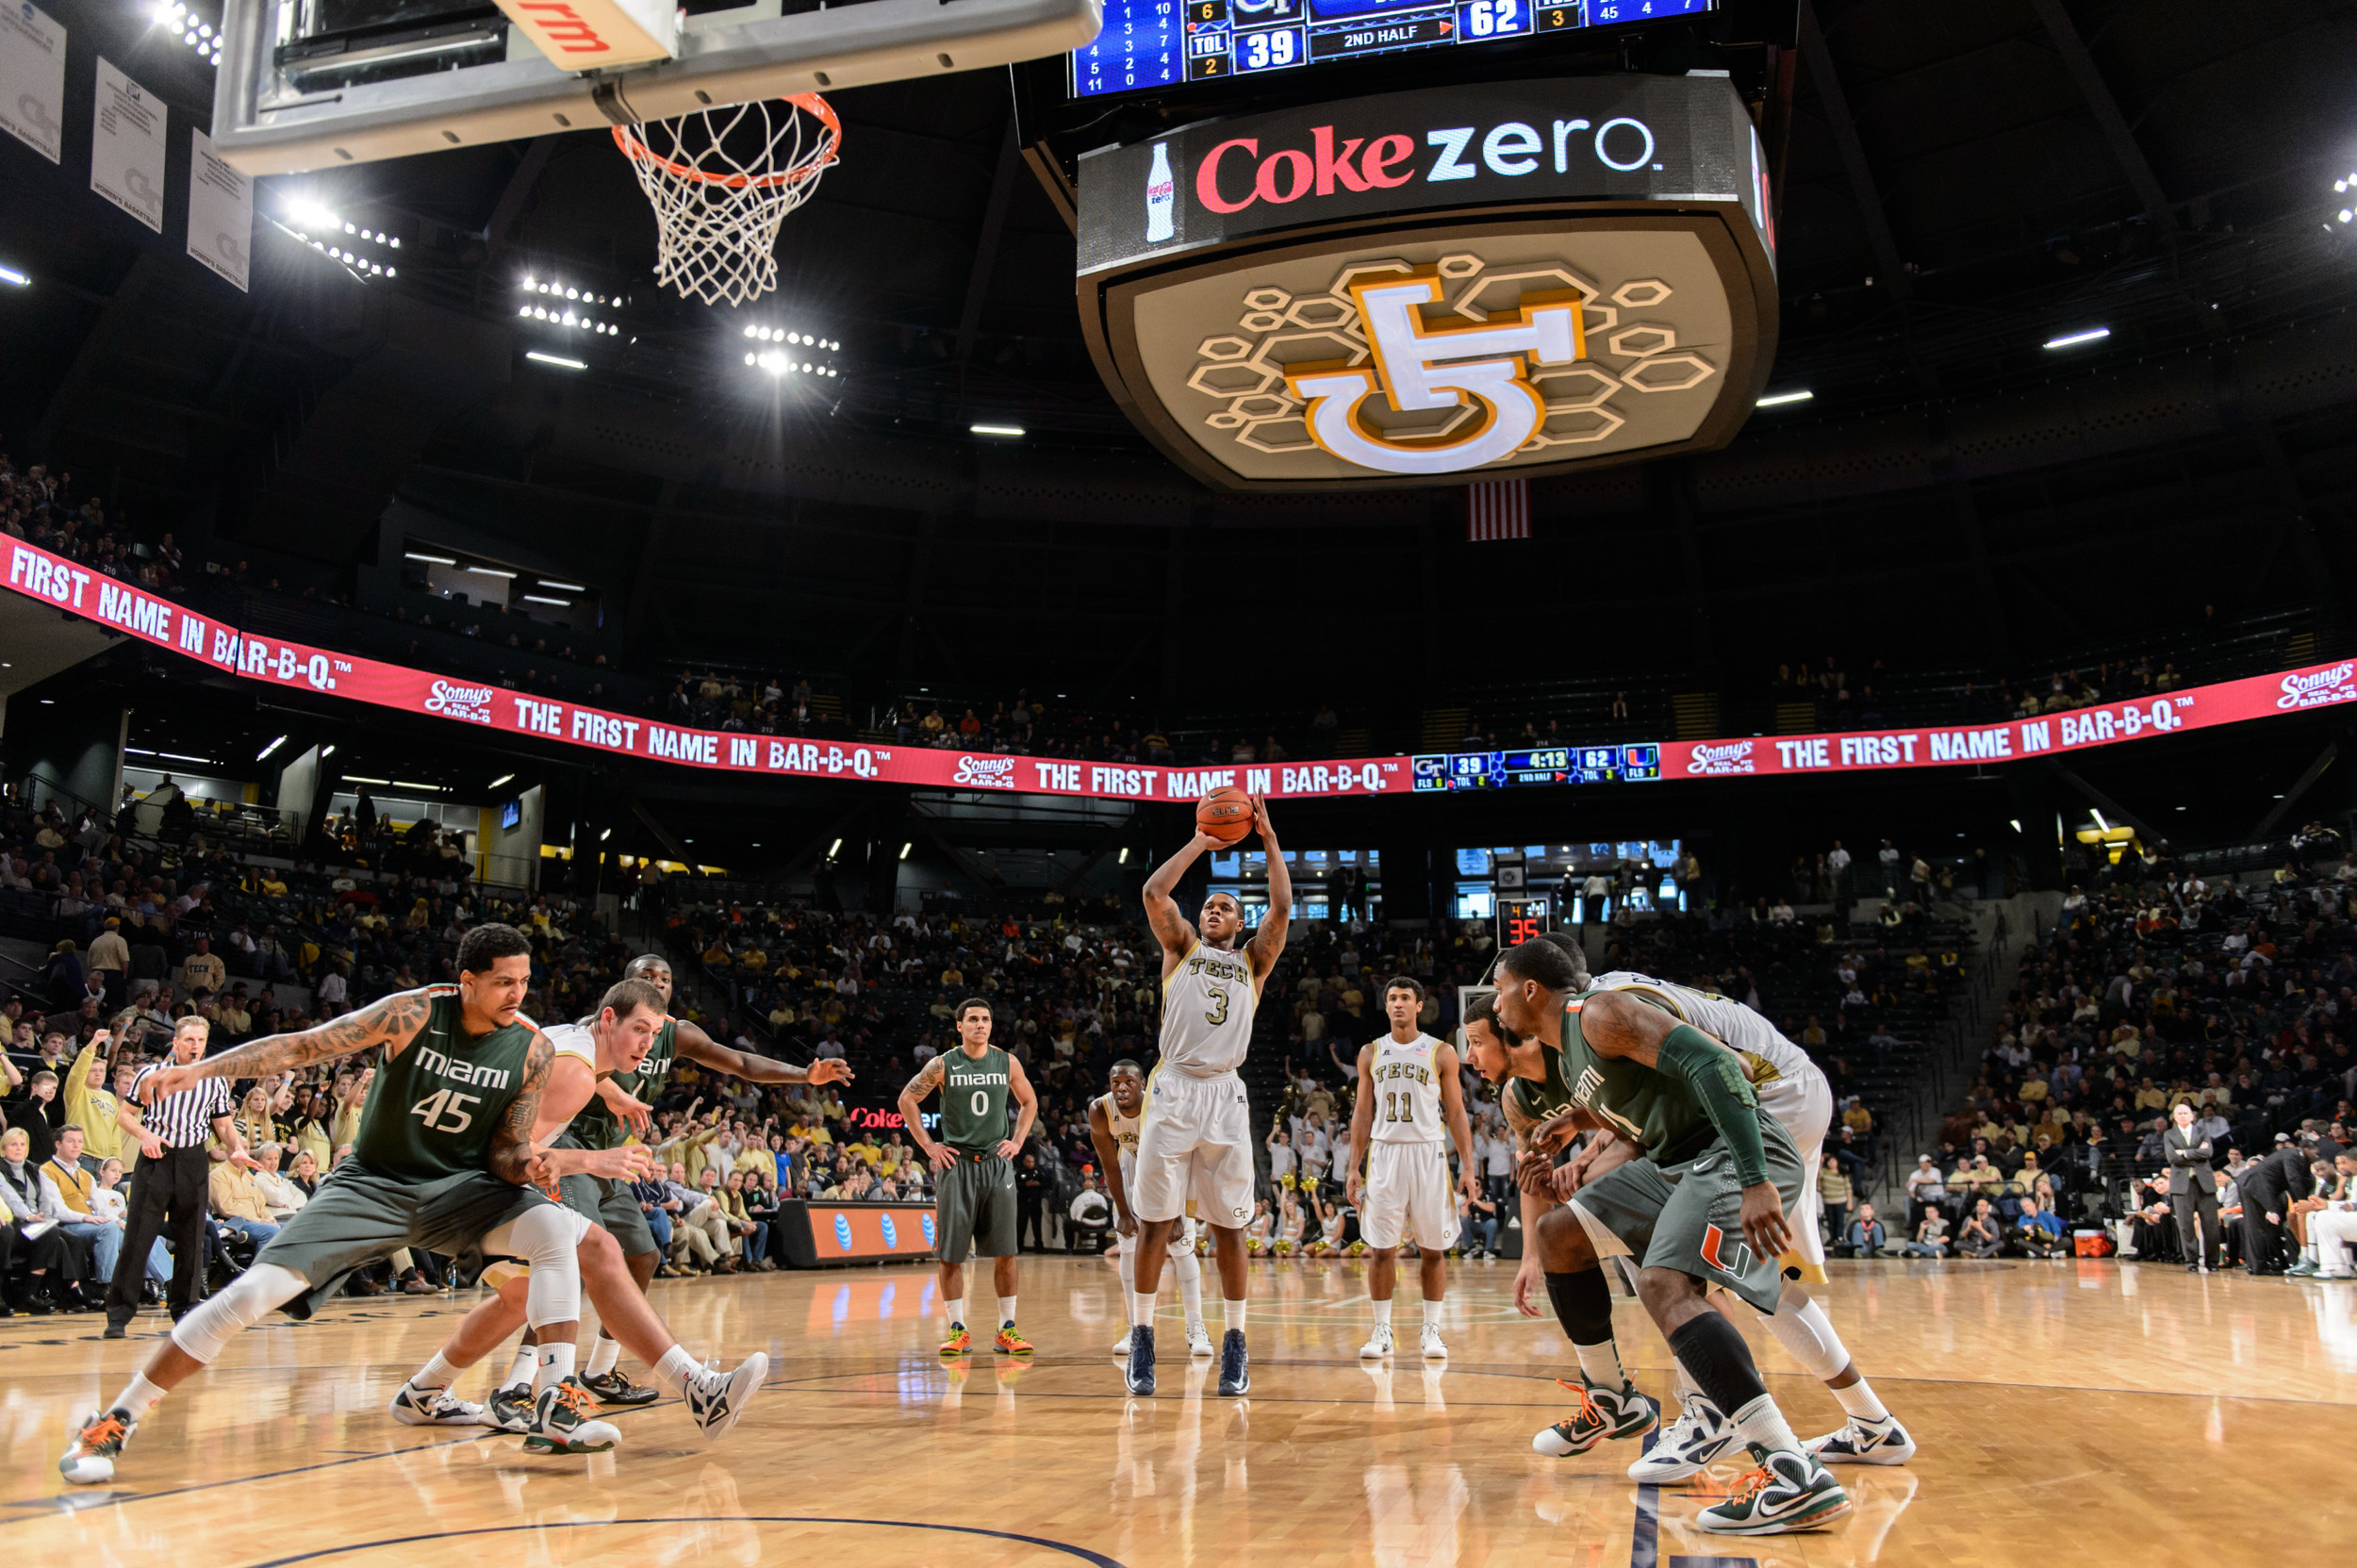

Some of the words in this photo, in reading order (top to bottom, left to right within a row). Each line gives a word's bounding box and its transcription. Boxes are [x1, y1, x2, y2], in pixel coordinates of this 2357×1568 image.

[1124, 8, 1131, 19] 1
[1155, 3, 1171, 15] 10
[1202, 4, 1213, 19] 6
[1600, 7, 1619, 20] 45
[1641, 2, 1653, 14] 4
[1159, 18, 1168, 29] 4
[1470, 0, 1519, 36] 62
[1552, 9, 1564, 26] 3
[1124, 24, 1133, 35] 3
[1344, 31, 1375, 47] 2ND
[1377, 25, 1418, 43] HALF
[1125, 41, 1134, 52] 3
[1160, 35, 1168, 47] 7
[1194, 35, 1224, 55] TOL
[1090, 45, 1098, 57] 4
[1247, 30, 1294, 69] 39
[1125, 58, 1134, 70] 2
[1160, 53, 1170, 64] 4
[1205, 58, 1217, 74] 2
[1091, 62, 1099, 74] 5
[1161, 68, 1170, 80] 4
[1088, 78, 1102, 91] 11
[1125, 74, 1134, 86] 0
[1195, 125, 1414, 214] Coke
[1426, 117, 1655, 182] zero
[104, 564, 117, 575] 210
[10, 545, 90, 607] FIRST
[97, 583, 172, 642] NAME
[179, 613, 205, 654] IN
[2276, 663, 2355, 709] Sonny's
[424, 680, 493, 711] Sonny's
[514, 698, 562, 735] THE
[571, 710, 639, 750] FIRST
[648, 726, 717, 764] NAME
[730, 738, 756, 767] IN
[1776, 739, 1830, 768] THE
[1840, 734, 1918, 766] FIRST
[1930, 728, 2012, 761] NAME
[2021, 720, 2051, 752] IN
[1529, 751, 1566, 768] 4:13
[1585, 750, 1608, 767] 62
[1627, 748, 1656, 767] U
[1687, 740, 1754, 773] Sonny's
[953, 755, 1015, 784] Sonny's
[1415, 759, 1444, 778] GT
[1458, 756, 1481, 774] 39
[1628, 767, 1644, 778] FLS
[1648, 767, 1656, 777] 7
[1035, 763, 1080, 791] THE
[1092, 767, 1157, 796] FIRST
[1167, 770, 1236, 799] NAME
[1246, 767, 1271, 795] IN
[1456, 776, 1471, 786] TOL
[1477, 775, 1485, 786] 2
[1519, 773, 1534, 783] 2ND
[1535, 772, 1552, 782] HALF
[1583, 770, 1599, 781] TOL
[1606, 768, 1613, 780] 3
[1417, 778, 1432, 788] FLS
[1435, 778, 1442, 787] 6
[1512, 906, 1521, 917] 4
[190, 965, 209, 973] TECH
[1190, 958, 1249, 987] TECH
[1205, 987, 1229, 1026] 3
[1376, 1063, 1429, 1086] TECH
[410, 1088, 482, 1133] 45
[970, 1090, 989, 1116] 0
[1386, 1092, 1412, 1122] 11
[850, 1107, 903, 1128] Coke
[1232, 1208, 1248, 1218] GT
[1179, 1238, 1193, 1247] GT
[1700, 1222, 1751, 1279] U
